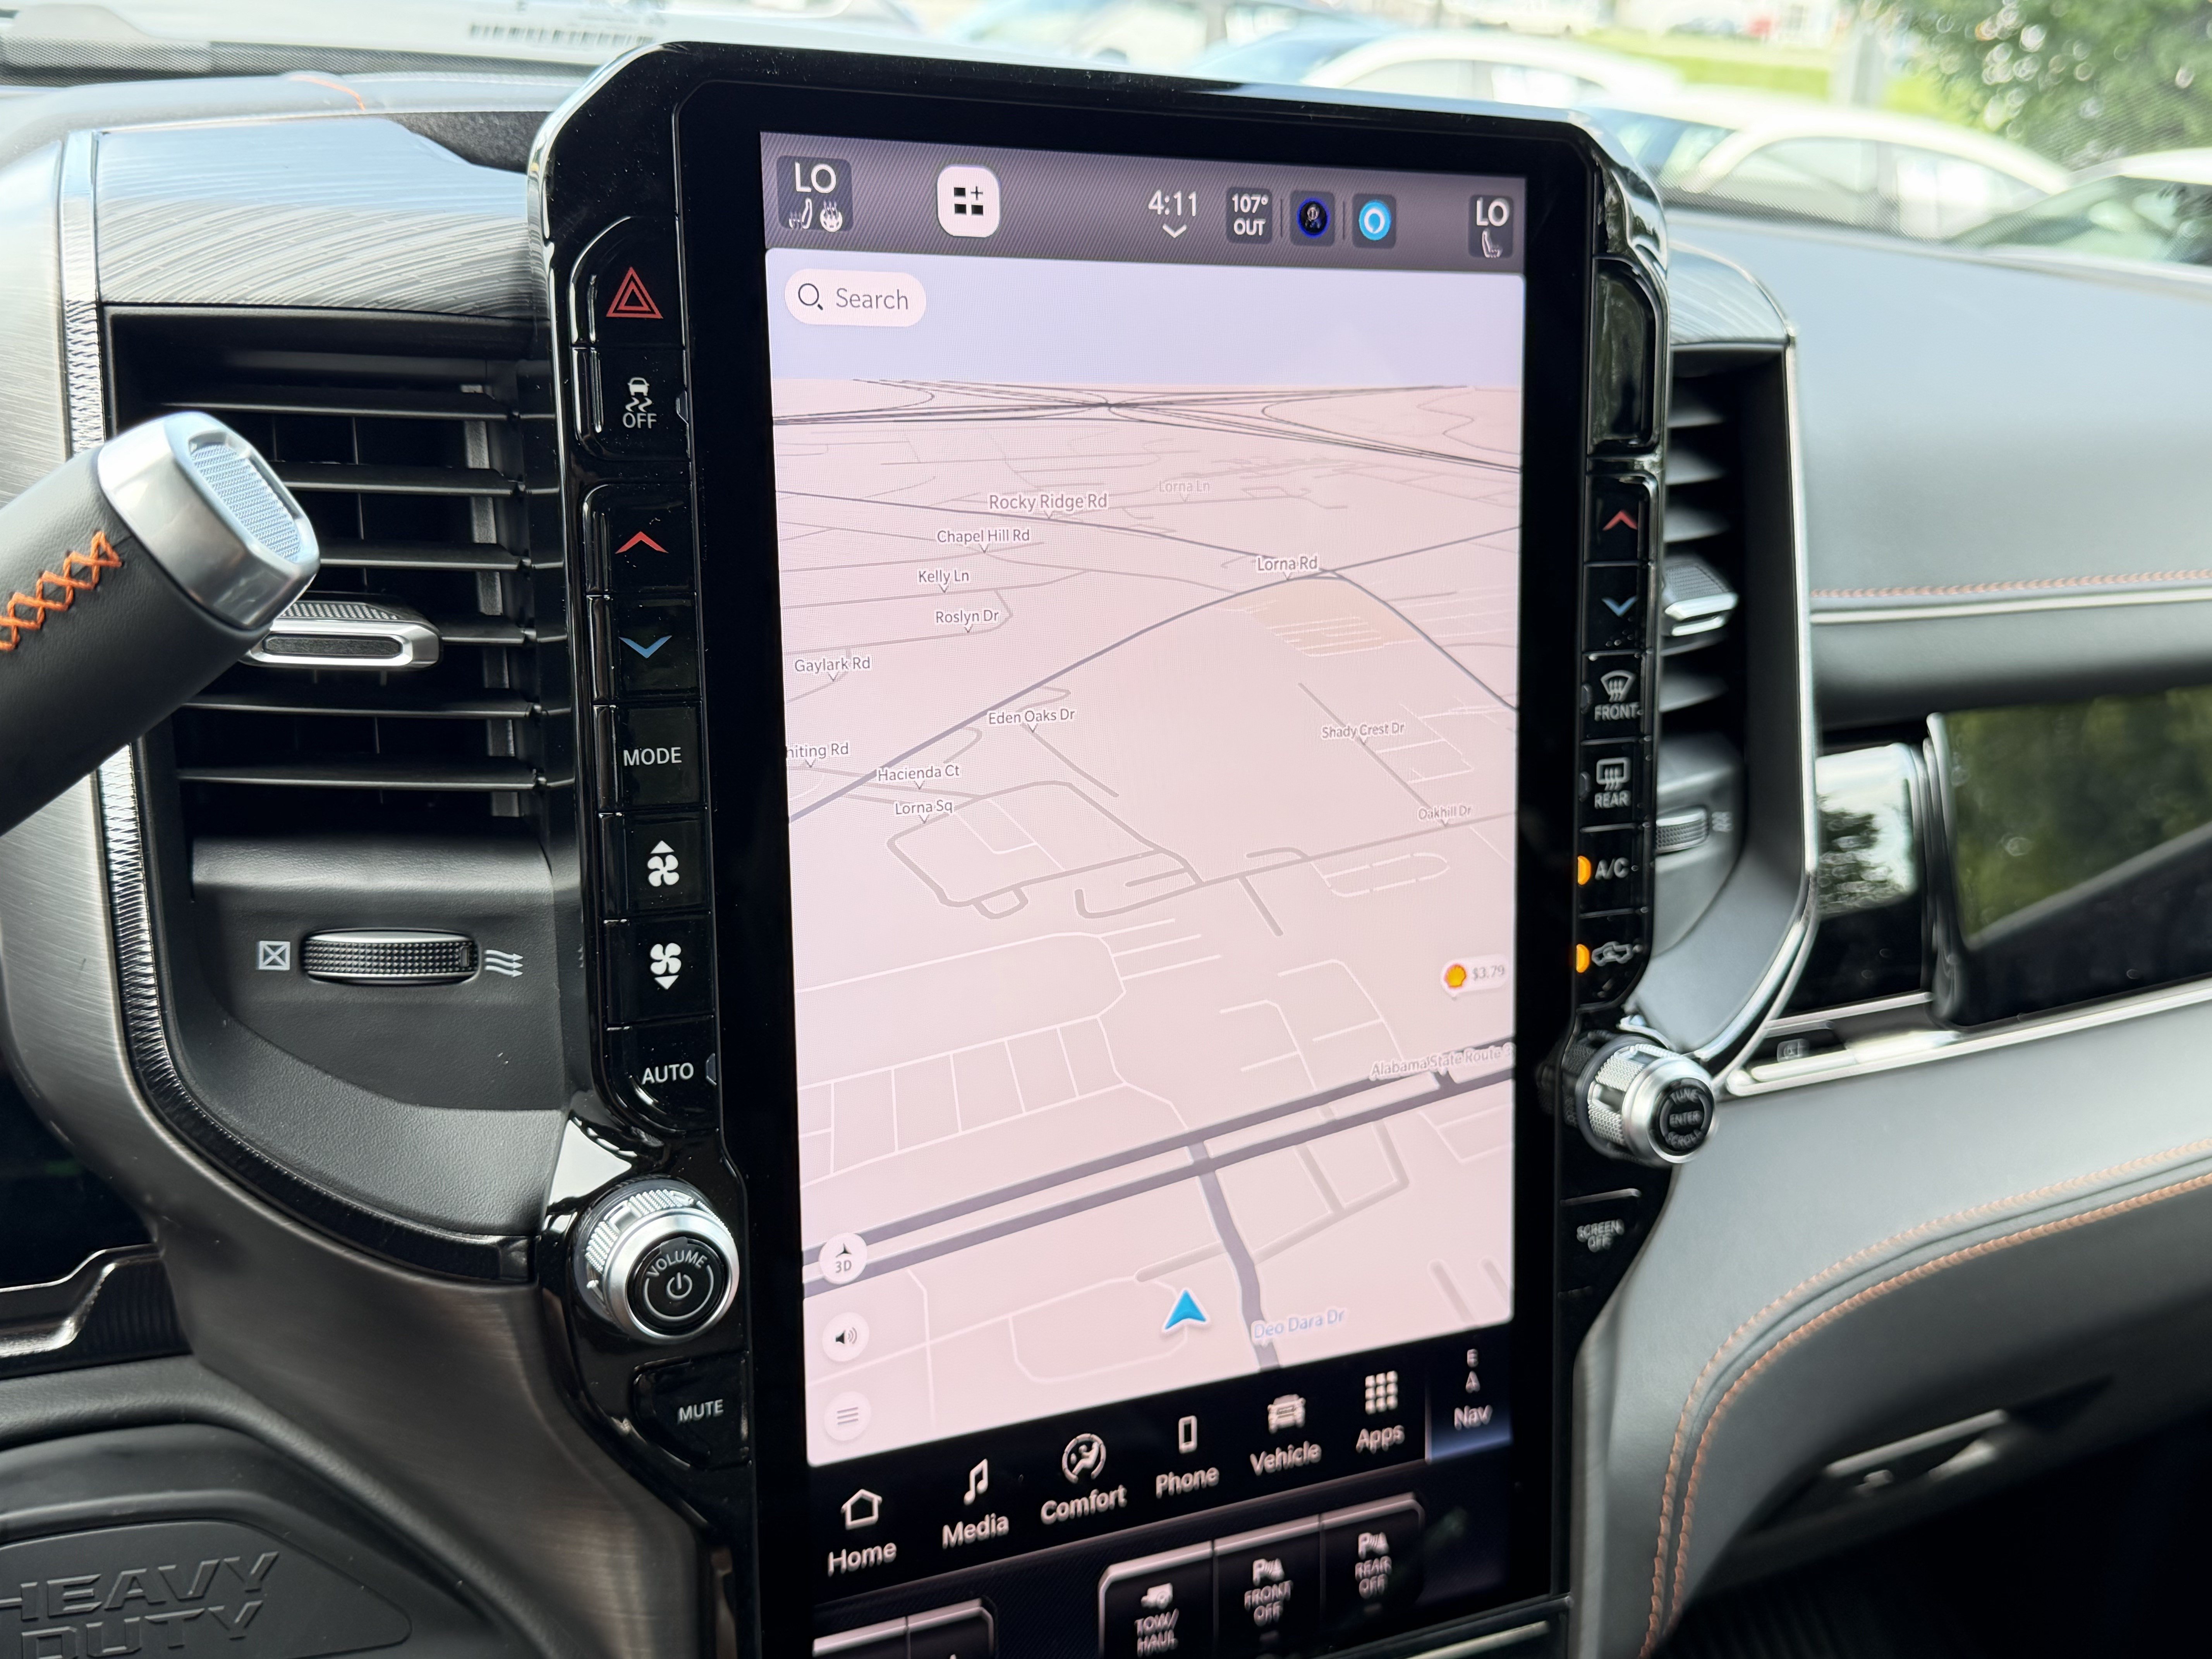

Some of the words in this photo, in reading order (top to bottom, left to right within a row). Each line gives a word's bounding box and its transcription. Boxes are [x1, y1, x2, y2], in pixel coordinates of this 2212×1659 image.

[795, 162, 836, 193] LO
[1148, 189, 1197, 217] 4:11
[1232, 193, 1269, 213] 107°
[1476, 197, 1510, 227] LO
[1234, 218, 1266, 236] OUT
[836, 288, 908, 310] Search
[623, 413, 657, 429] OFF
[1159, 480, 1193, 492] Lorna
[1197, 479, 1210, 492] Ln
[989, 494, 1036, 512] Rocky
[1040, 494, 1084, 511] Ridge
[1088, 493, 1108, 508] Rd
[938, 529, 984, 546] Chapel
[988, 529, 1010, 542] Hill
[1013, 529, 1030, 541] Rd
[1258, 557, 1296, 571] Lorna
[1300, 556, 1317, 569] Rd
[919, 569, 950, 586] Kelly
[954, 569, 969, 582] Ln
[936, 610, 980, 626] Roslyn
[983, 609, 999, 622] Dr
[795, 658, 848, 675] Gaylark
[853, 657, 871, 670] Rd
[989, 711, 1020, 725] Eden
[1024, 709, 1057, 723] Oaks
[1060, 708, 1075, 721] Dr
[1595, 702, 1640, 721] FRONT
[1322, 726, 1356, 739] Shady
[1360, 724, 1388, 736] Crest
[1391, 723, 1406, 733] Dr
[623, 747, 682, 766] MODE
[831, 742, 848, 755] Rd
[878, 766, 941, 782] Hacienda
[945, 765, 959, 777] Ct
[895, 802, 933, 815] Lorna
[936, 800, 952, 815] Sq
[1595, 790, 1631, 809] REAR
[1418, 806, 1456, 820] Oakhill
[1459, 805, 1471, 815] Dr
[1472, 965, 1505, 981] $3.79
[1371, 1058, 1427, 1076] Alabama
[1430, 1054, 1462, 1068] State
[1466, 1049, 1500, 1063] Route
[642, 1062, 694, 1085] AUTO
[646, 1250, 708, 1278] VOLUME
[835, 1260, 852, 1273] 3D
[1254, 1322, 1283, 1339] Deo
[1288, 1315, 1323, 1333] Dara
[1327, 1309, 1345, 1324] Dr
[678, 1399, 723, 1424] MUTE
[1454, 1405, 1493, 1431] Nav
[1356, 1425, 1405, 1454] Apps
[1250, 1441, 1322, 1476] Vehicle
[1156, 1467, 1219, 1498] Phone
[1041, 1485, 1127, 1525] Comfort
[942, 1513, 1009, 1549] Media
[828, 1542, 896, 1577] Home
[1355, 1556, 1392, 1582] REAR
[0, 1551, 279, 1621] HEAVY
[1244, 1580, 1293, 1612] FRONT
[22, 1600, 263, 1659] DUTY
